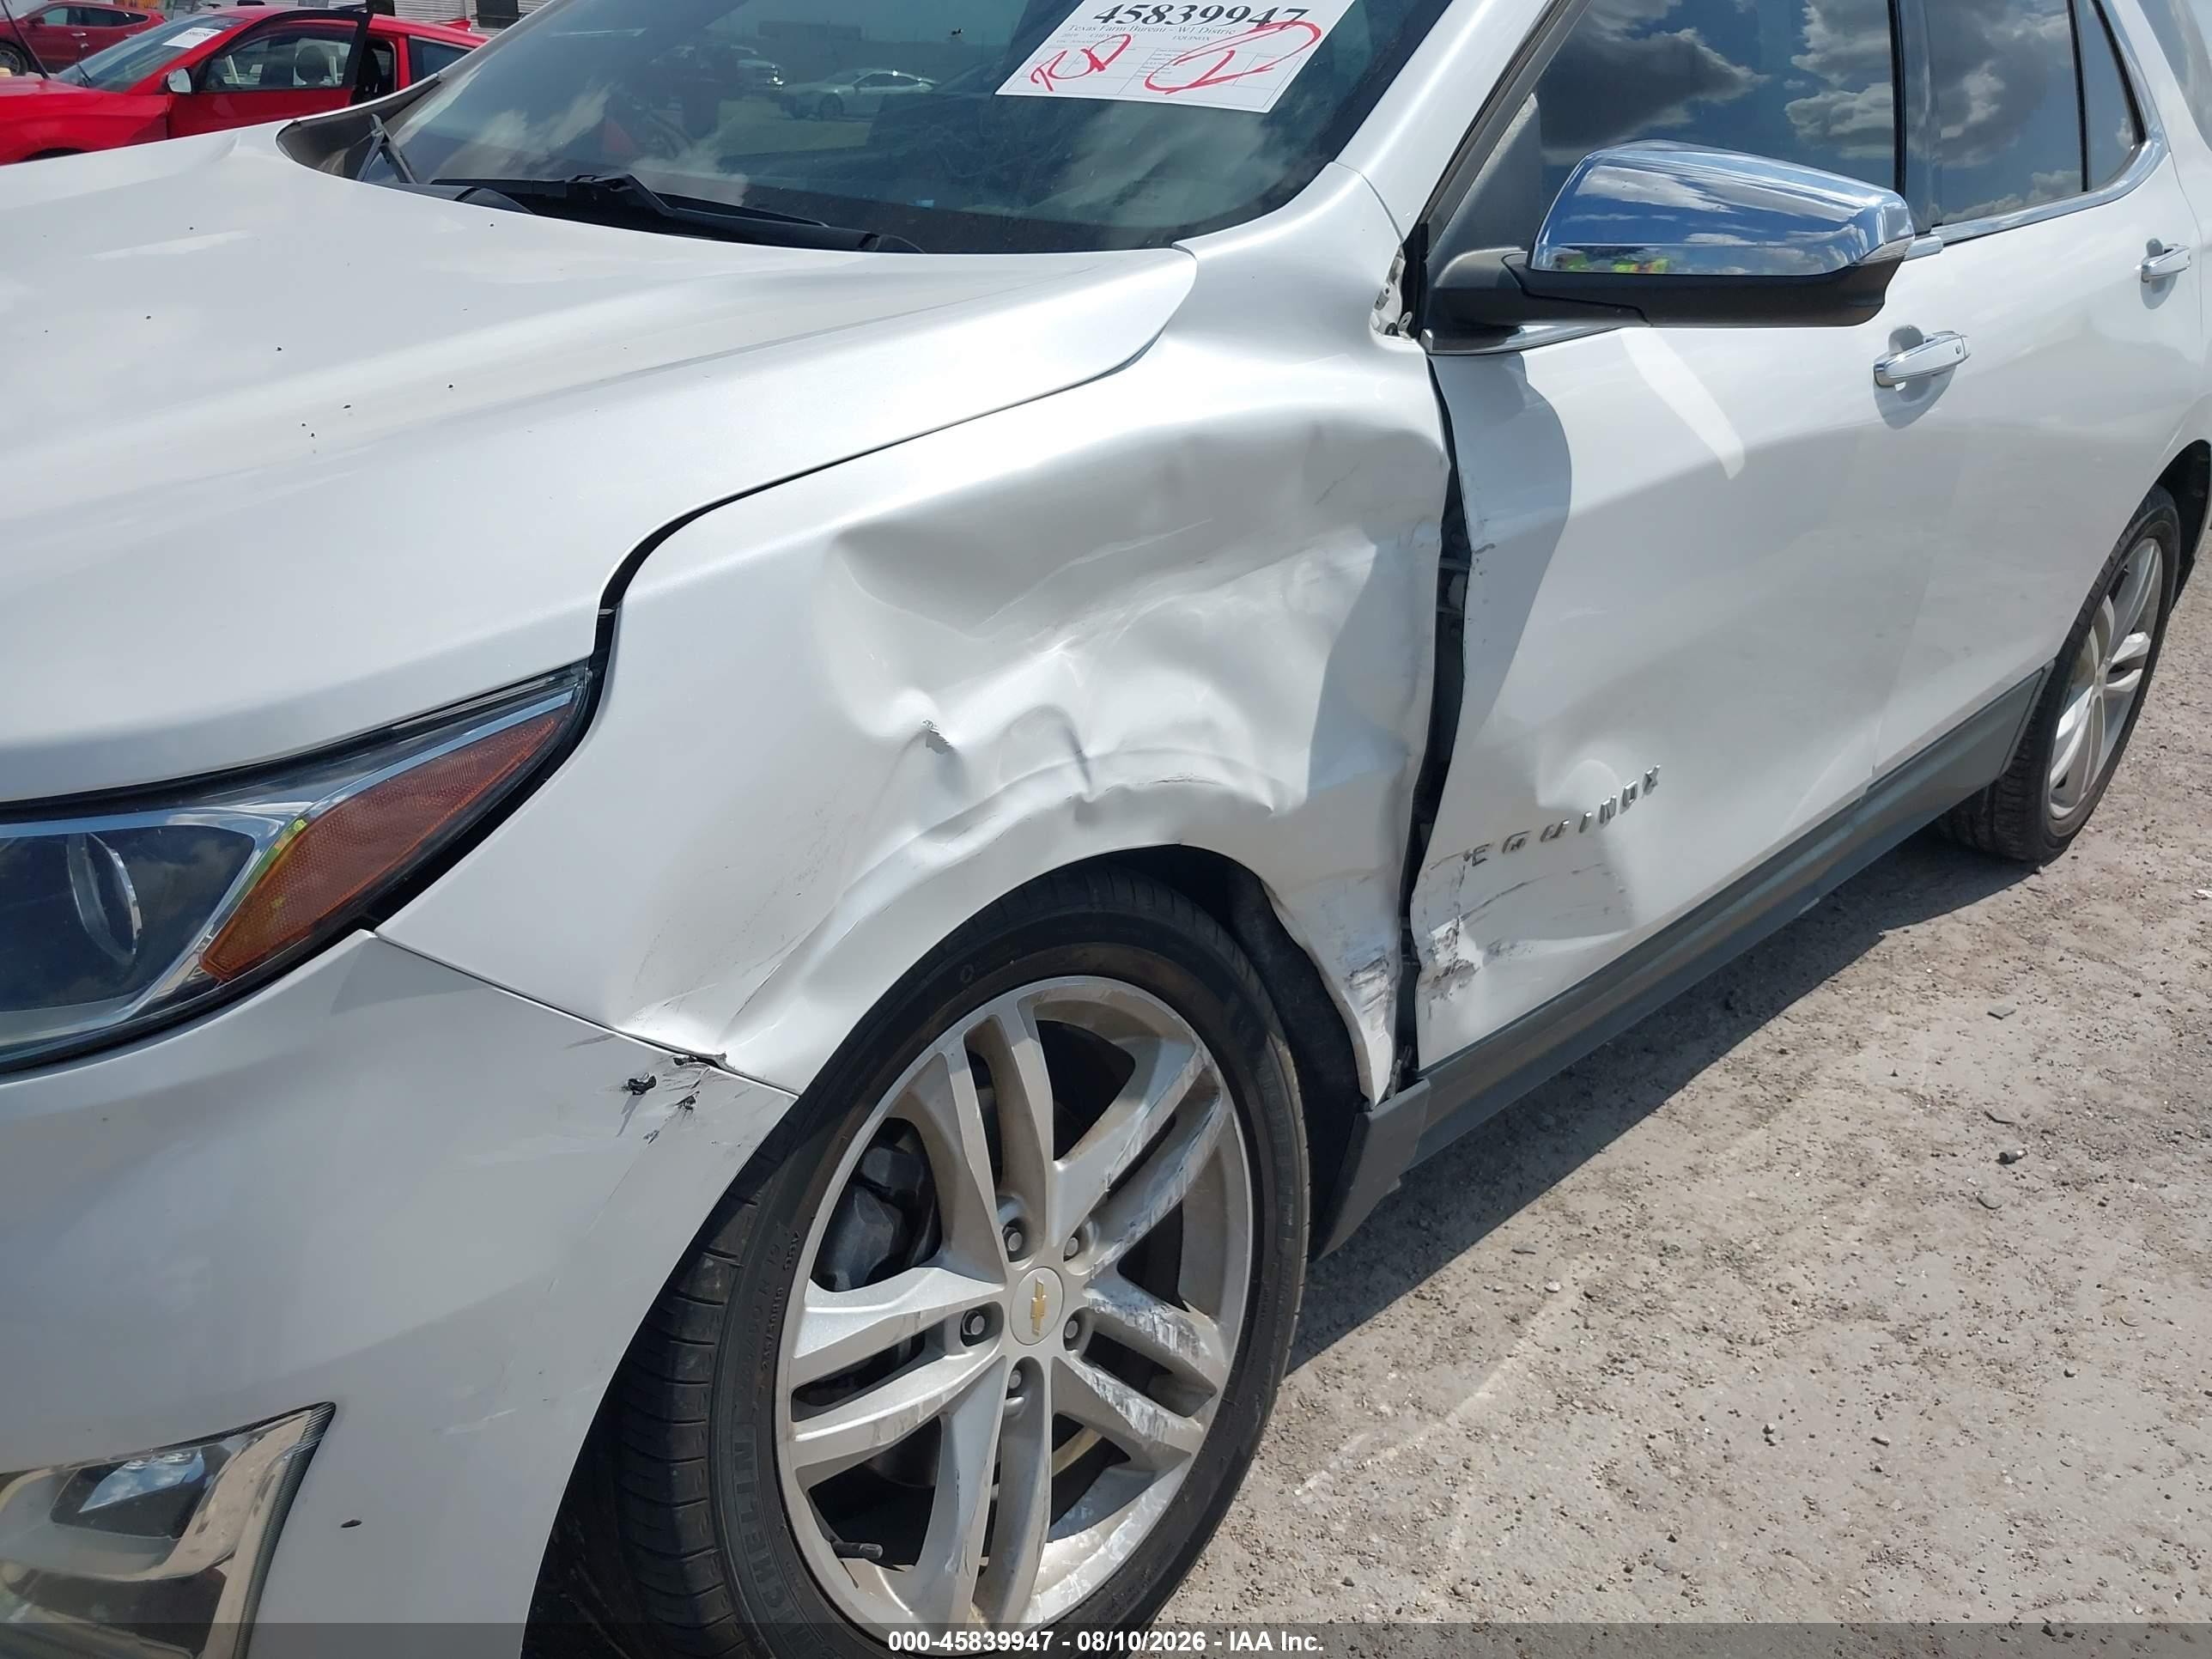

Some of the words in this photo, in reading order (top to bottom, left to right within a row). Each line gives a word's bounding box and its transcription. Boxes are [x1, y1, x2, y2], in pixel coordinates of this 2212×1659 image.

[1093, 4, 1310, 29] 45839947
[1471, 764, 1661, 866] EQUINOX
[733, 1442, 815, 1656] MICHELIN
